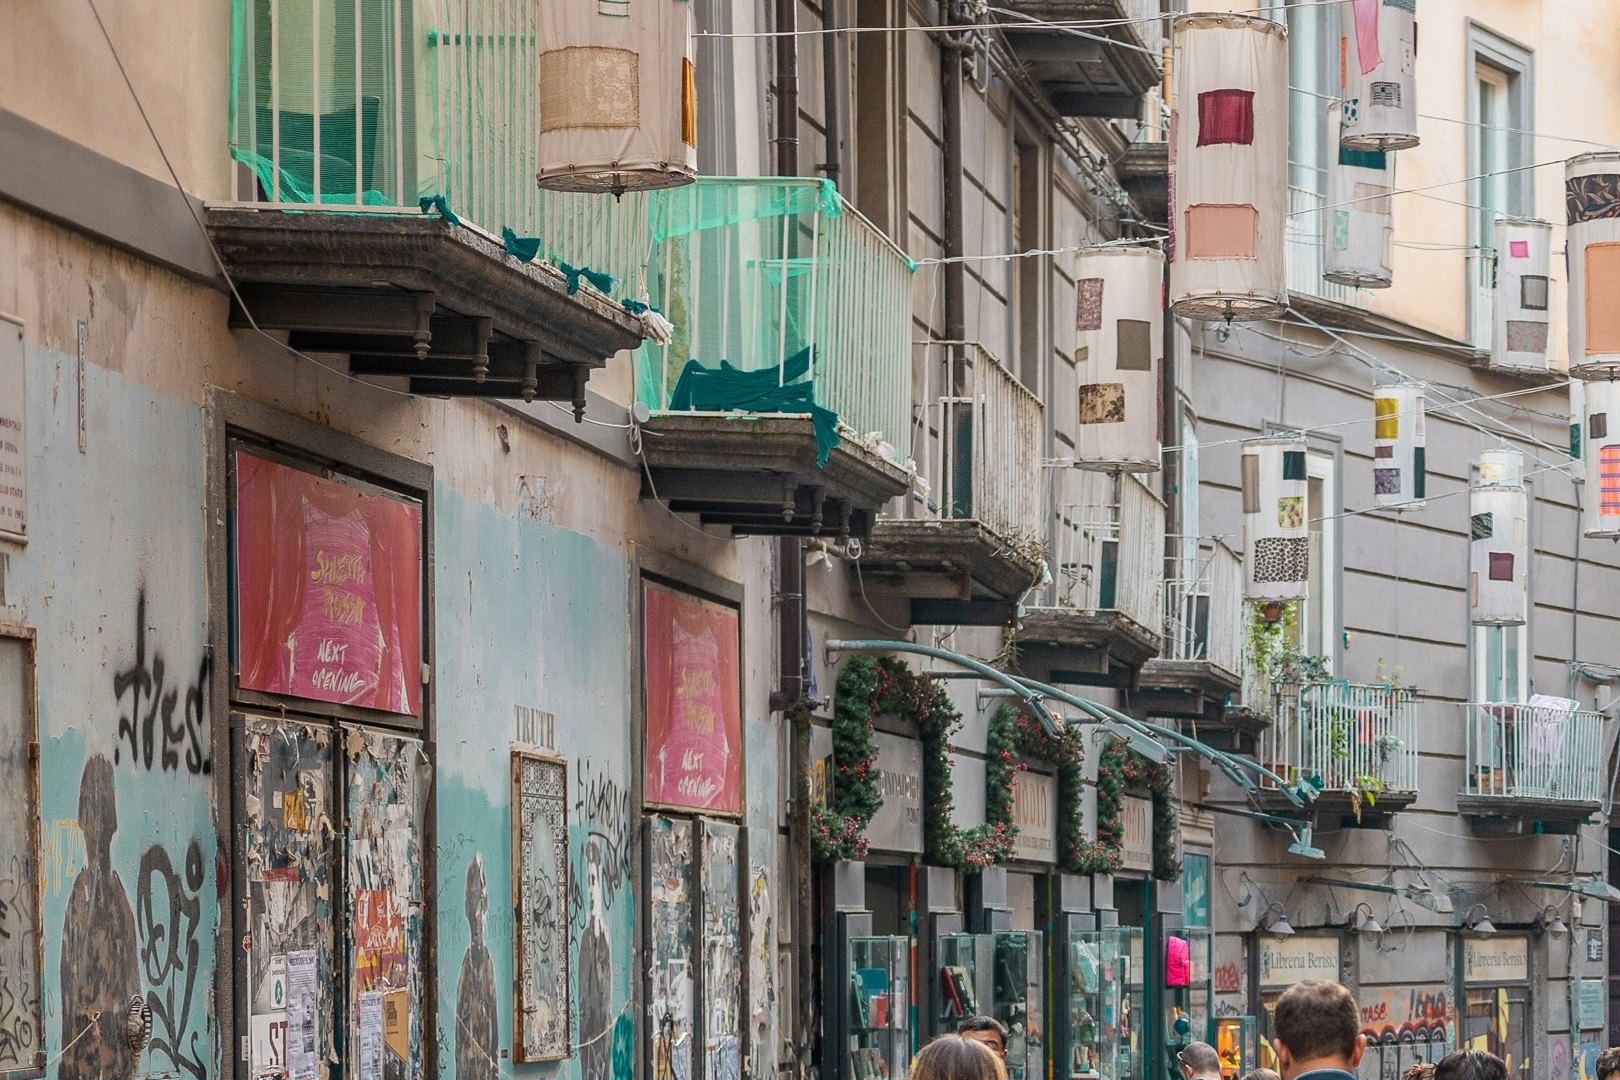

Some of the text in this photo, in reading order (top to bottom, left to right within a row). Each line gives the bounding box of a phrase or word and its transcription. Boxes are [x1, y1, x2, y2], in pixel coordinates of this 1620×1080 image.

[317, 637, 349, 664] NEXT
[312, 668, 367, 693] OPENING
[513, 703, 555, 750] TRUTH
[681, 748, 704, 771] NEXT
[678, 775, 716, 797] OPENING
[1270, 951, 1337, 970] Libreria Berisio
[1473, 949, 1528, 968] Libreria Berisio
